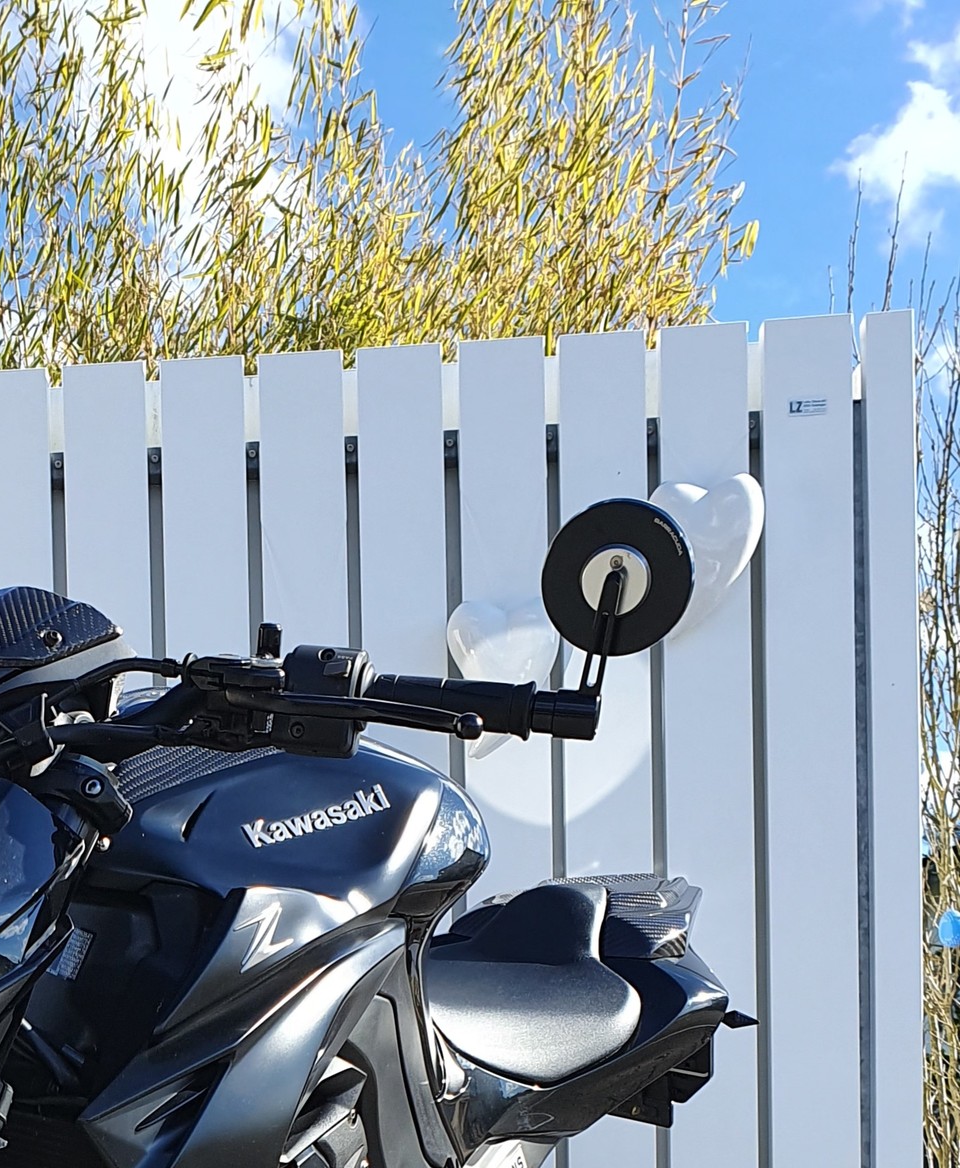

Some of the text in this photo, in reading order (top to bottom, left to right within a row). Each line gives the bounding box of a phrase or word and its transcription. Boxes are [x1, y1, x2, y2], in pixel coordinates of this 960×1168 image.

[789, 401, 803, 413] LZ
[653, 517, 684, 557] BARRACUDA
[240, 784, 391, 848] Kawasaki
